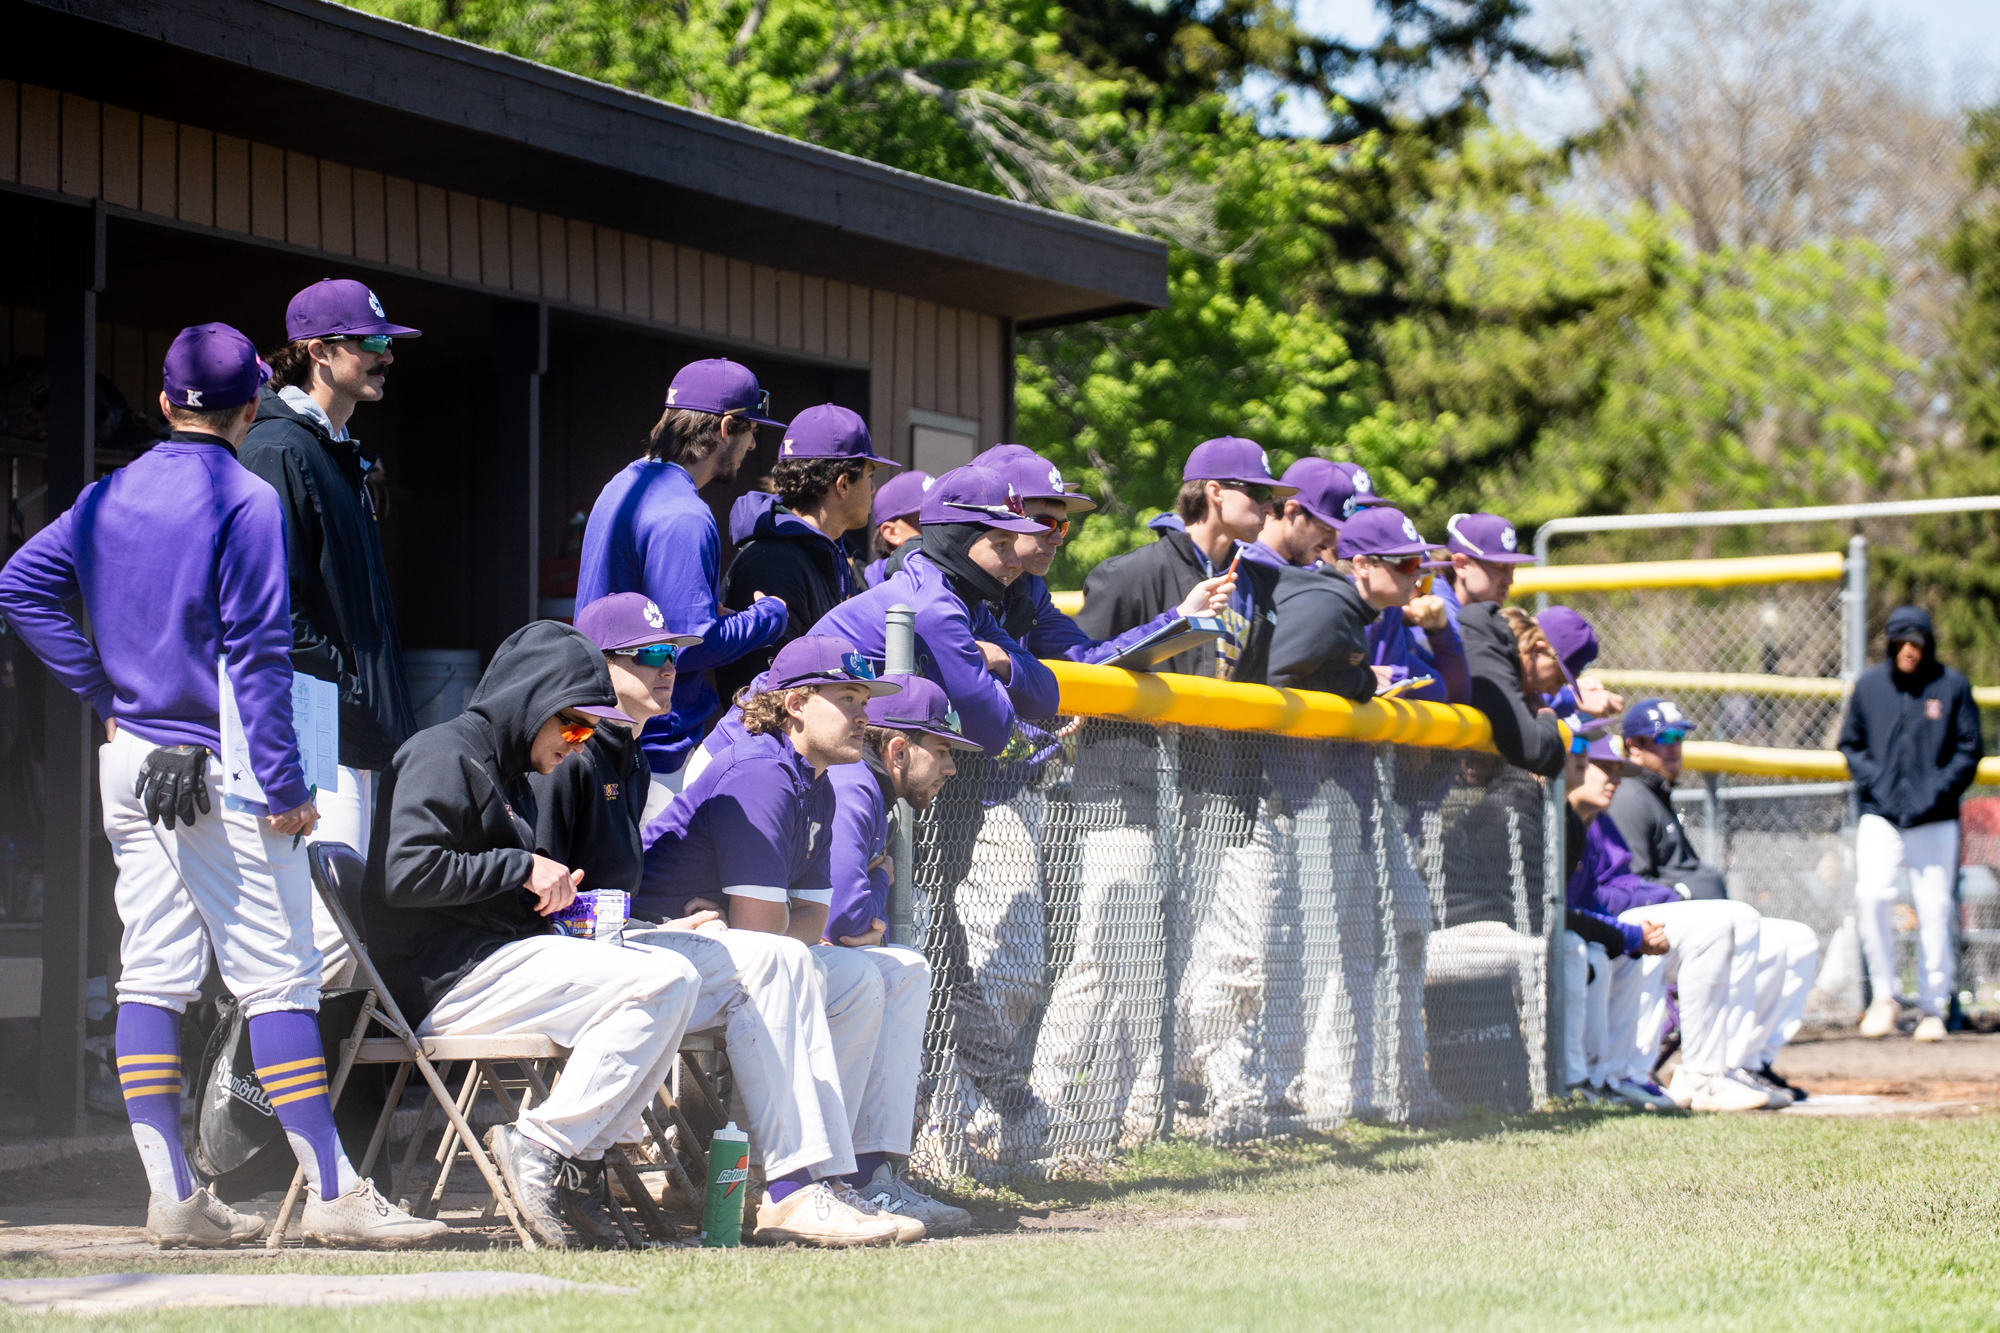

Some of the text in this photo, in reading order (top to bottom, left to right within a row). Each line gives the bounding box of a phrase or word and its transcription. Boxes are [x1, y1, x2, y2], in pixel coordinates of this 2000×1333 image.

[186, 388, 203, 407] K
[784, 439, 793, 455] K
[560, 905, 591, 918] BIGGER
